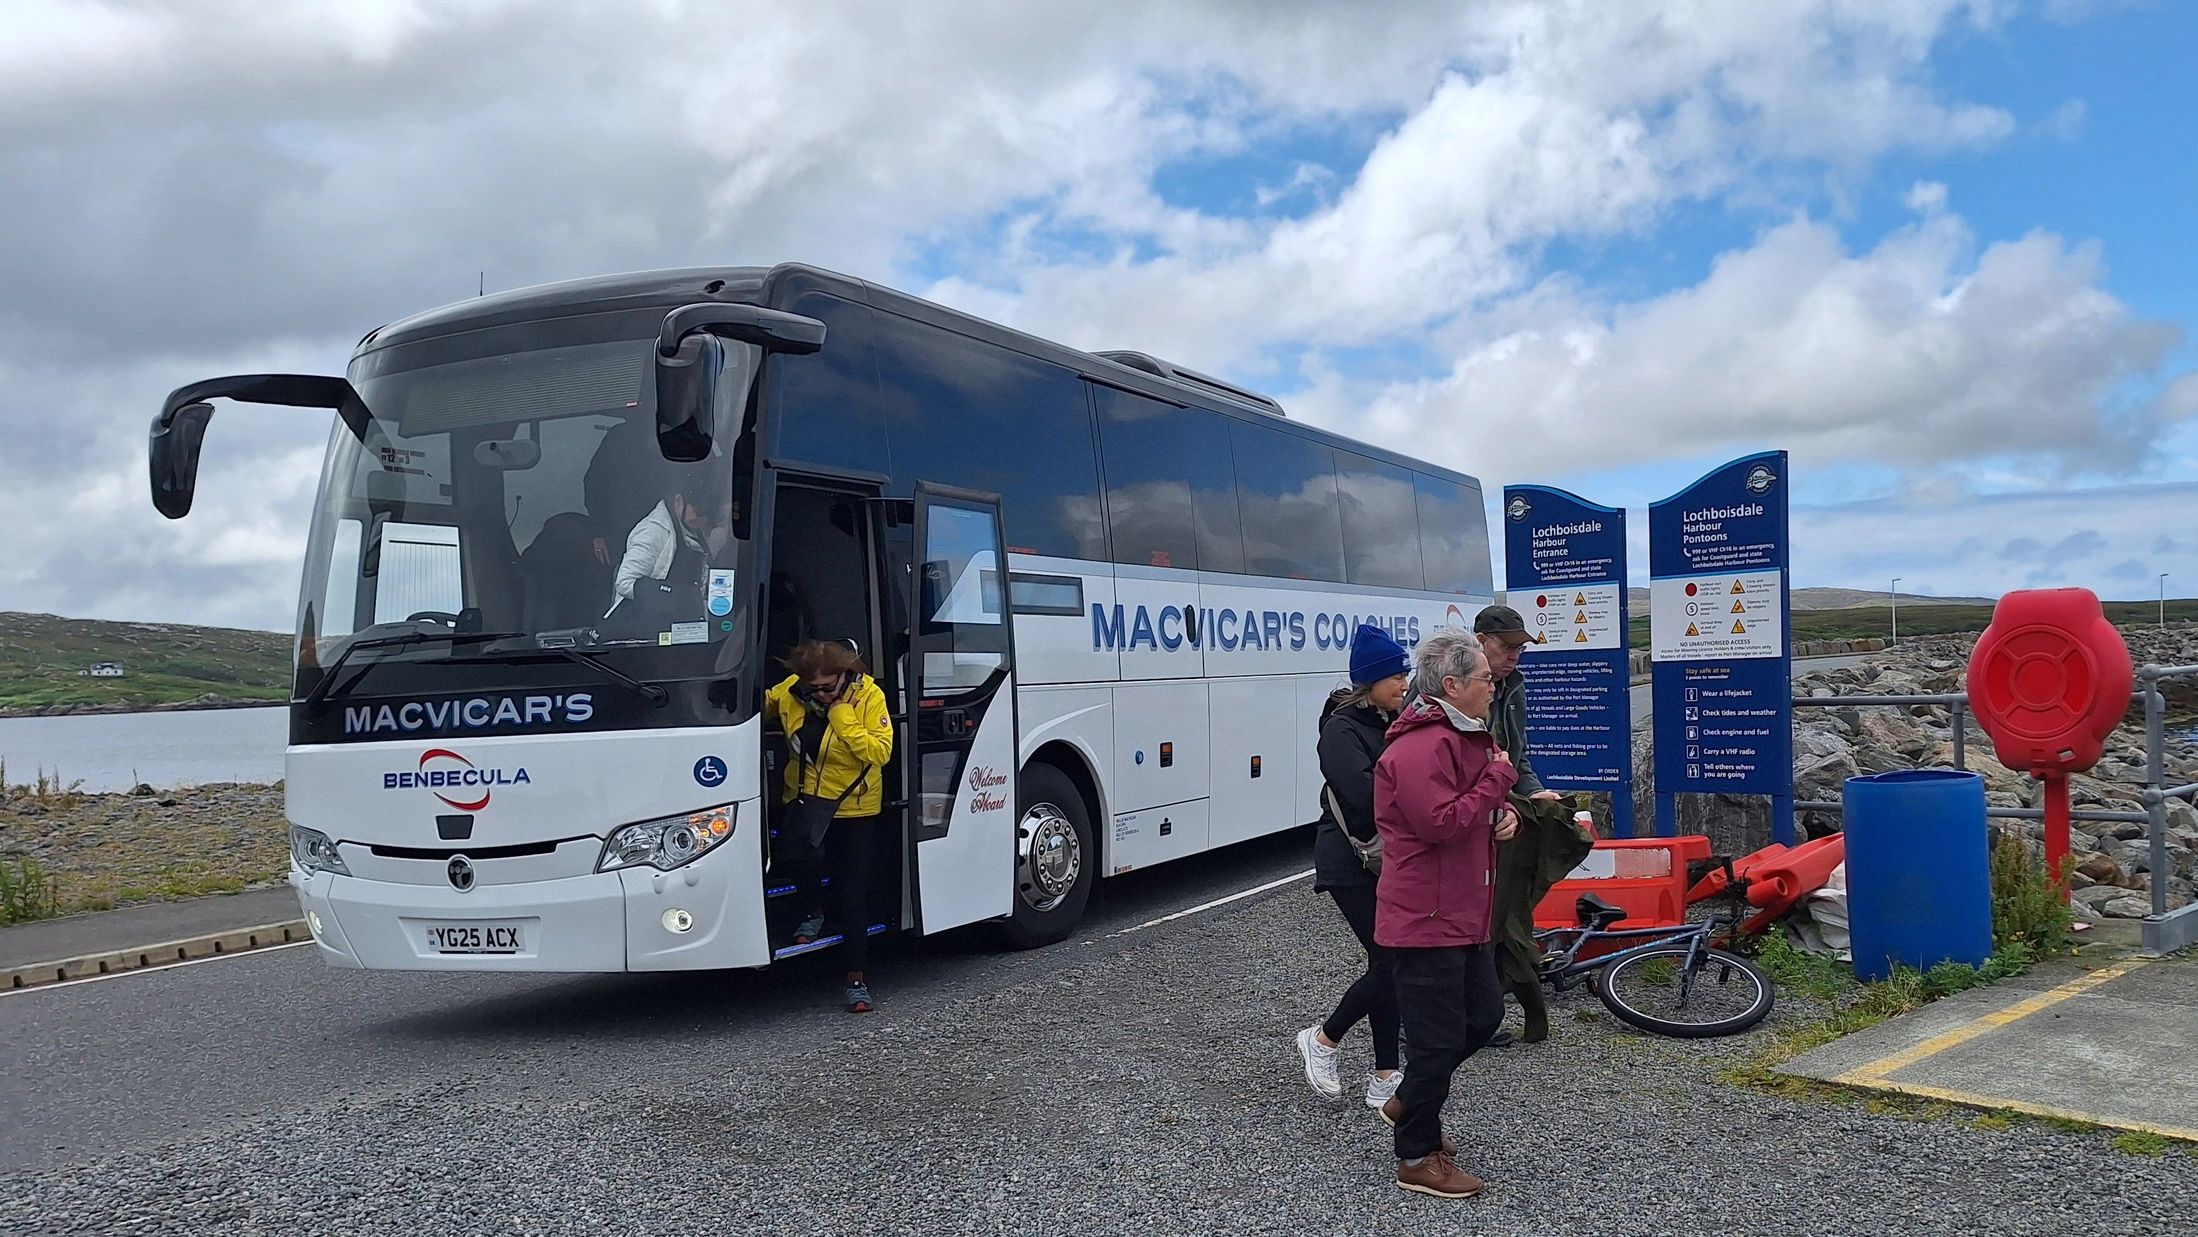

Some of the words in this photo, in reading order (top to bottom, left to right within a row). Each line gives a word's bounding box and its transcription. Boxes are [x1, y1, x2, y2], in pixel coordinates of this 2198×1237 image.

[1684, 503, 1763, 523] Lochboisdale
[1532, 520, 1602, 538] Lochboisdale
[1684, 523, 1722, 533] Harbour
[1533, 538, 1566, 548] Harbour
[1684, 533, 1727, 544] Pontoons
[1533, 548, 1568, 558] Entrance
[344, 694, 593, 733] MACVICAR'S
[1722, 729, 1743, 737] engine
[384, 768, 531, 789] BENBECULA
[969, 765, 1008, 791] Welcome
[971, 791, 1007, 814] Aboard
[436, 928, 481, 947] YG25
[487, 928, 519, 947] ACX
